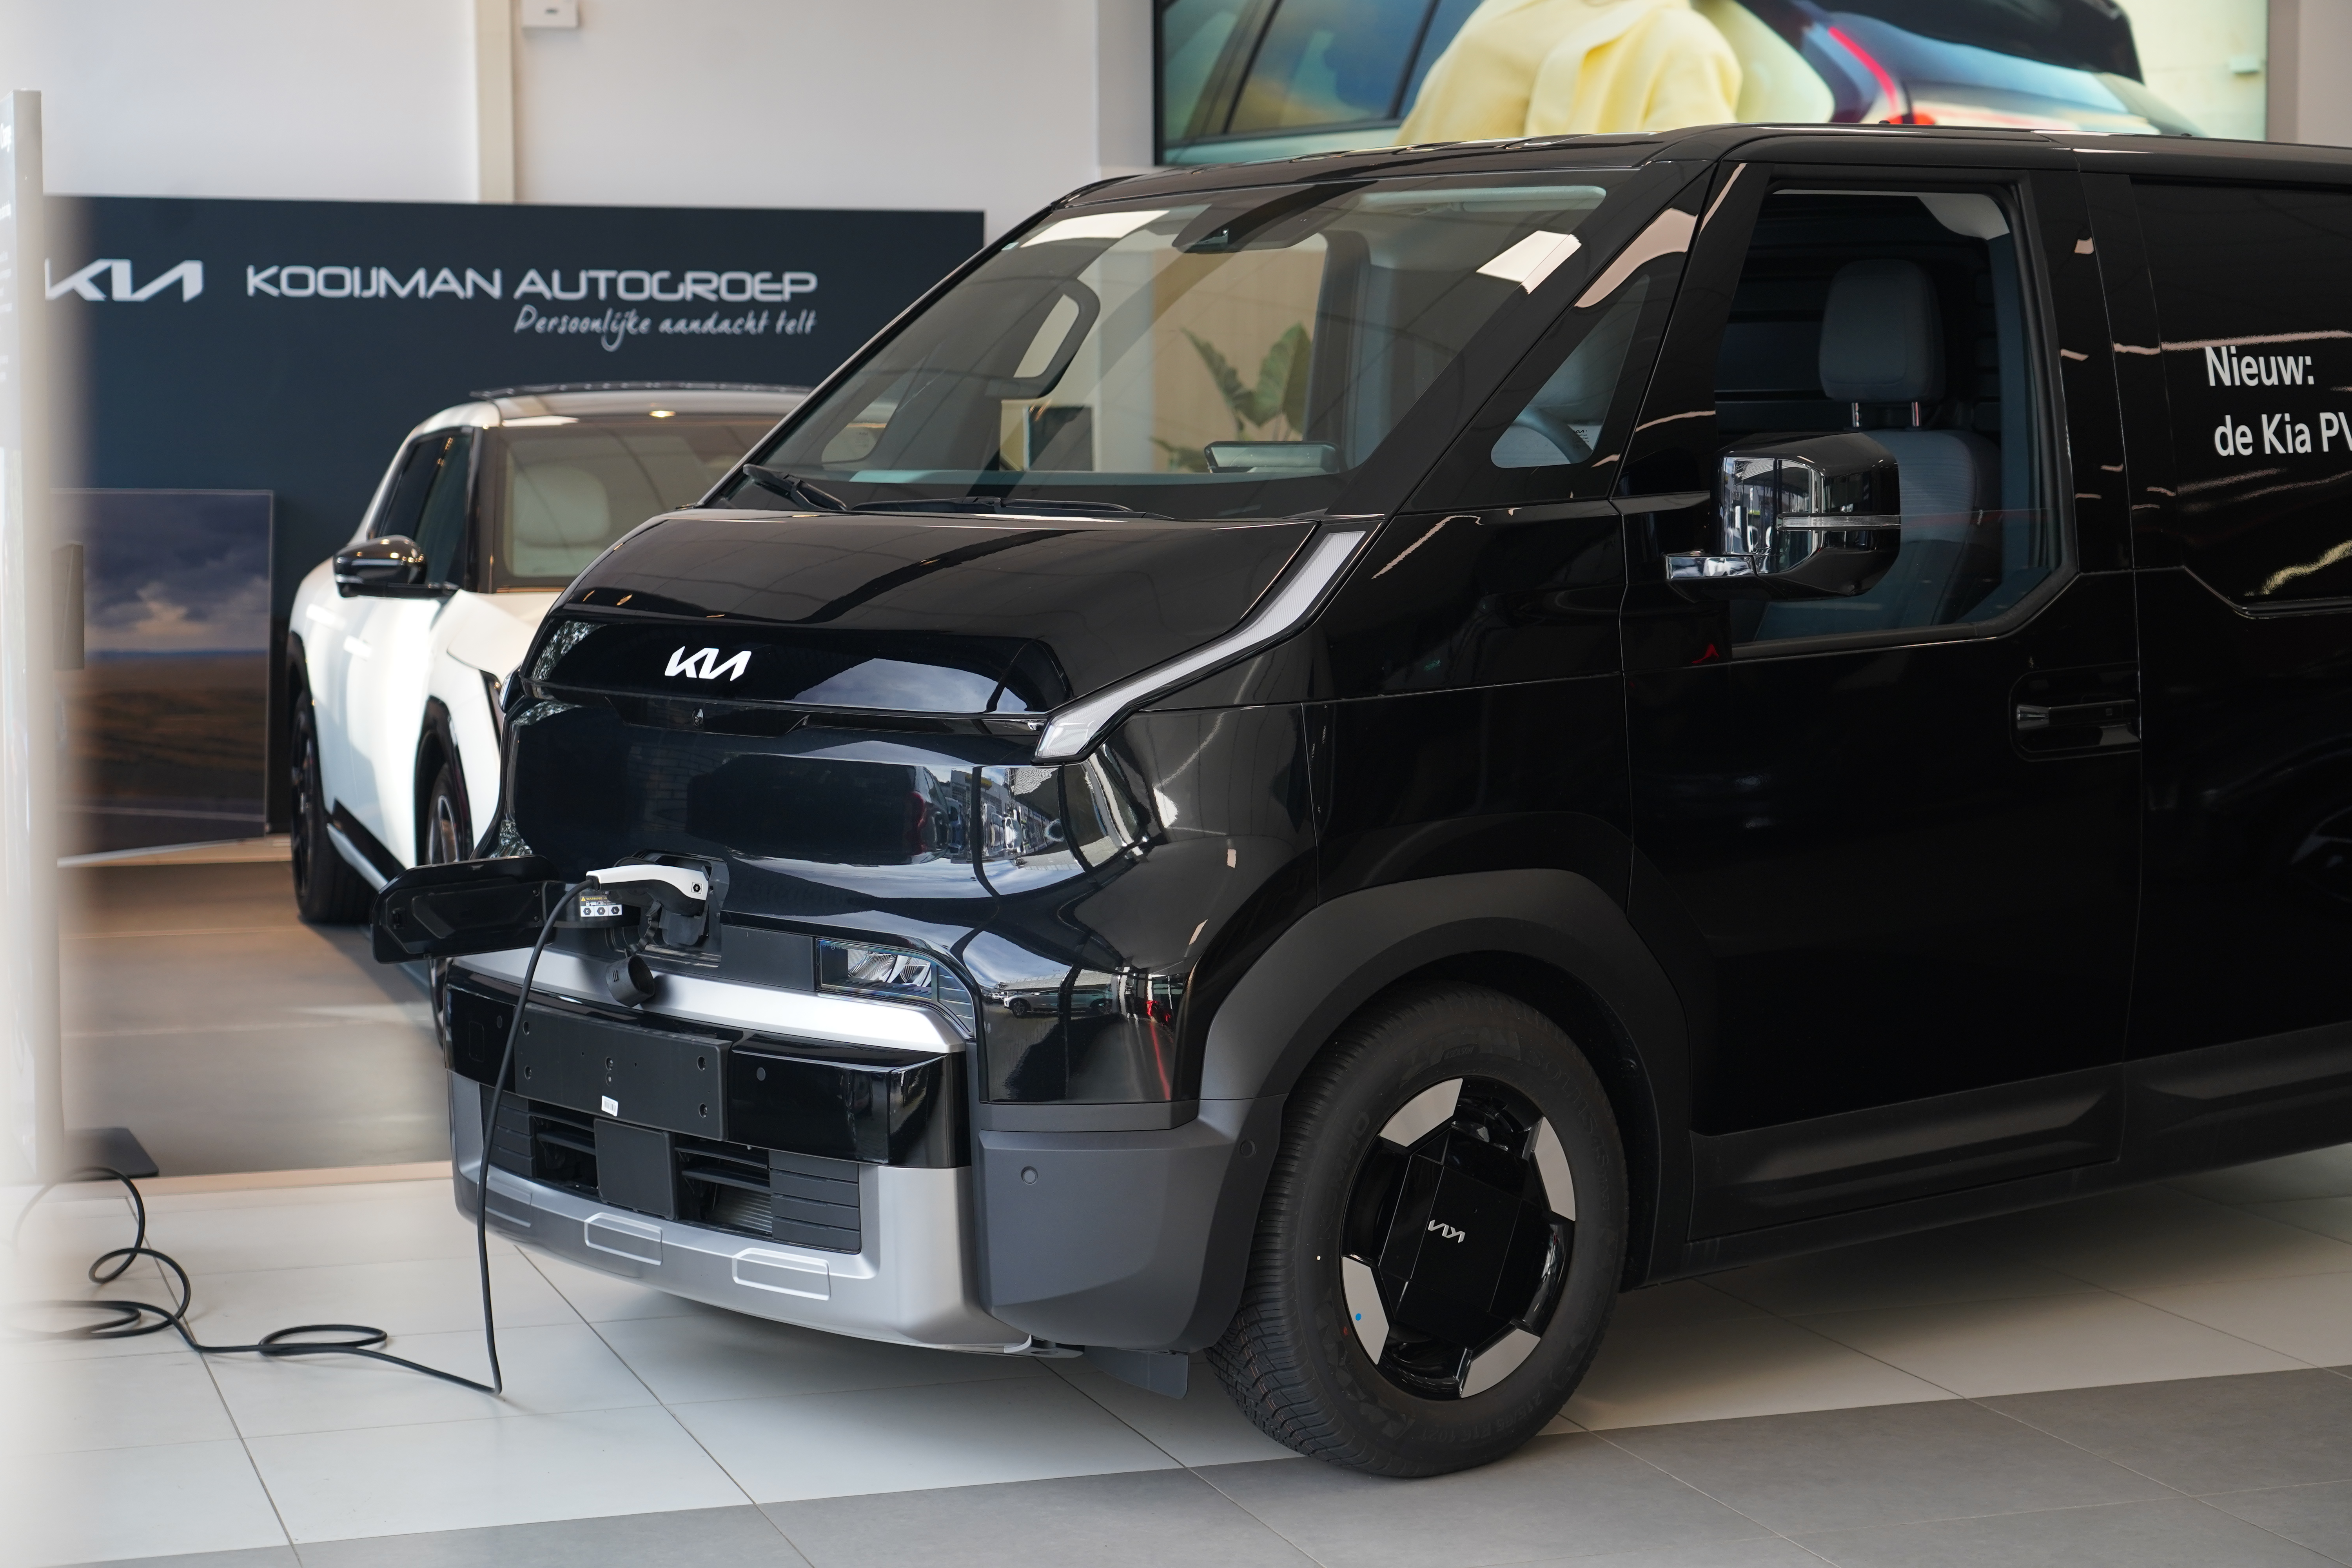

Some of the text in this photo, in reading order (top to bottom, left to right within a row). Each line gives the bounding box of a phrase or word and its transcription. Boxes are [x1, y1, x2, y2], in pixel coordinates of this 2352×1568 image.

[247, 264, 818, 302] KOOIJMAN AUTOGROEP
[514, 304, 817, 352] Persoonlijke aandacht telt
[2205, 345, 2314, 387] Nieuw:
[2215, 414, 2253, 456] de
[2261, 413, 2312, 454] Kia
[664, 646, 752, 681] KIA
